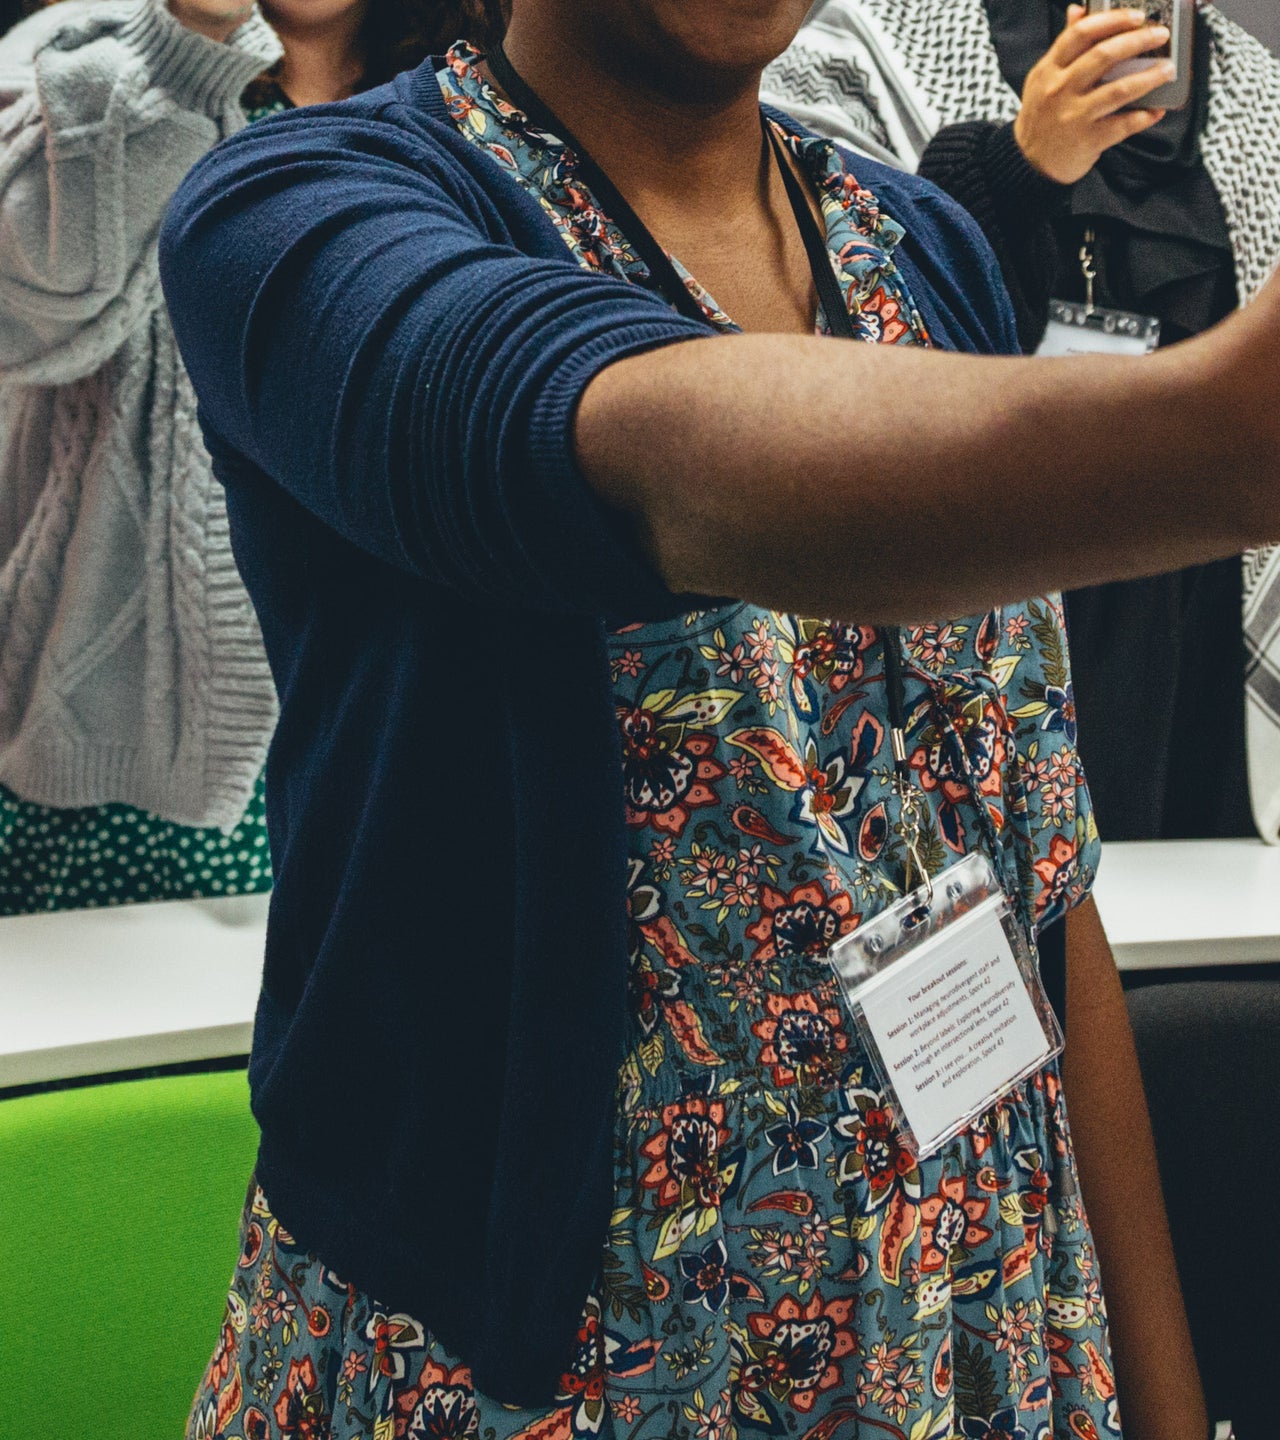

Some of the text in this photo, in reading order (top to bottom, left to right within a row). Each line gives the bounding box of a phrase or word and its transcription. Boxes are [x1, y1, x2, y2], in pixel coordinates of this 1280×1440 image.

[886, 1021, 908, 1040] Session
[913, 999, 940, 1020] Managing
[939, 971, 978, 1002] neurodivergent
[977, 961, 989, 976] staff
[990, 955, 1001, 967] and
[907, 991, 921, 1003] Your
[920, 973, 946, 995] breakout
[909, 1016, 936, 1038] workplace
[968, 982, 983, 997] Space
[893, 1053, 914, 1072] Session
[919, 1033, 940, 1053] Beyond
[956, 1005, 981, 1026] Exploring
[979, 981, 1015, 1009] neurodiversity
[911, 1054, 934, 1073] through
[940, 1022, 975, 1052] intersectional
[986, 1004, 1002, 1019] Space
[914, 1074, 936, 1093] Session
[944, 1060, 954, 1071] see
[973, 1031, 993, 1050] creative
[993, 1014, 1017, 1034] invitation
[941, 1075, 952, 1089] and
[981, 1043, 997, 1059] Space
